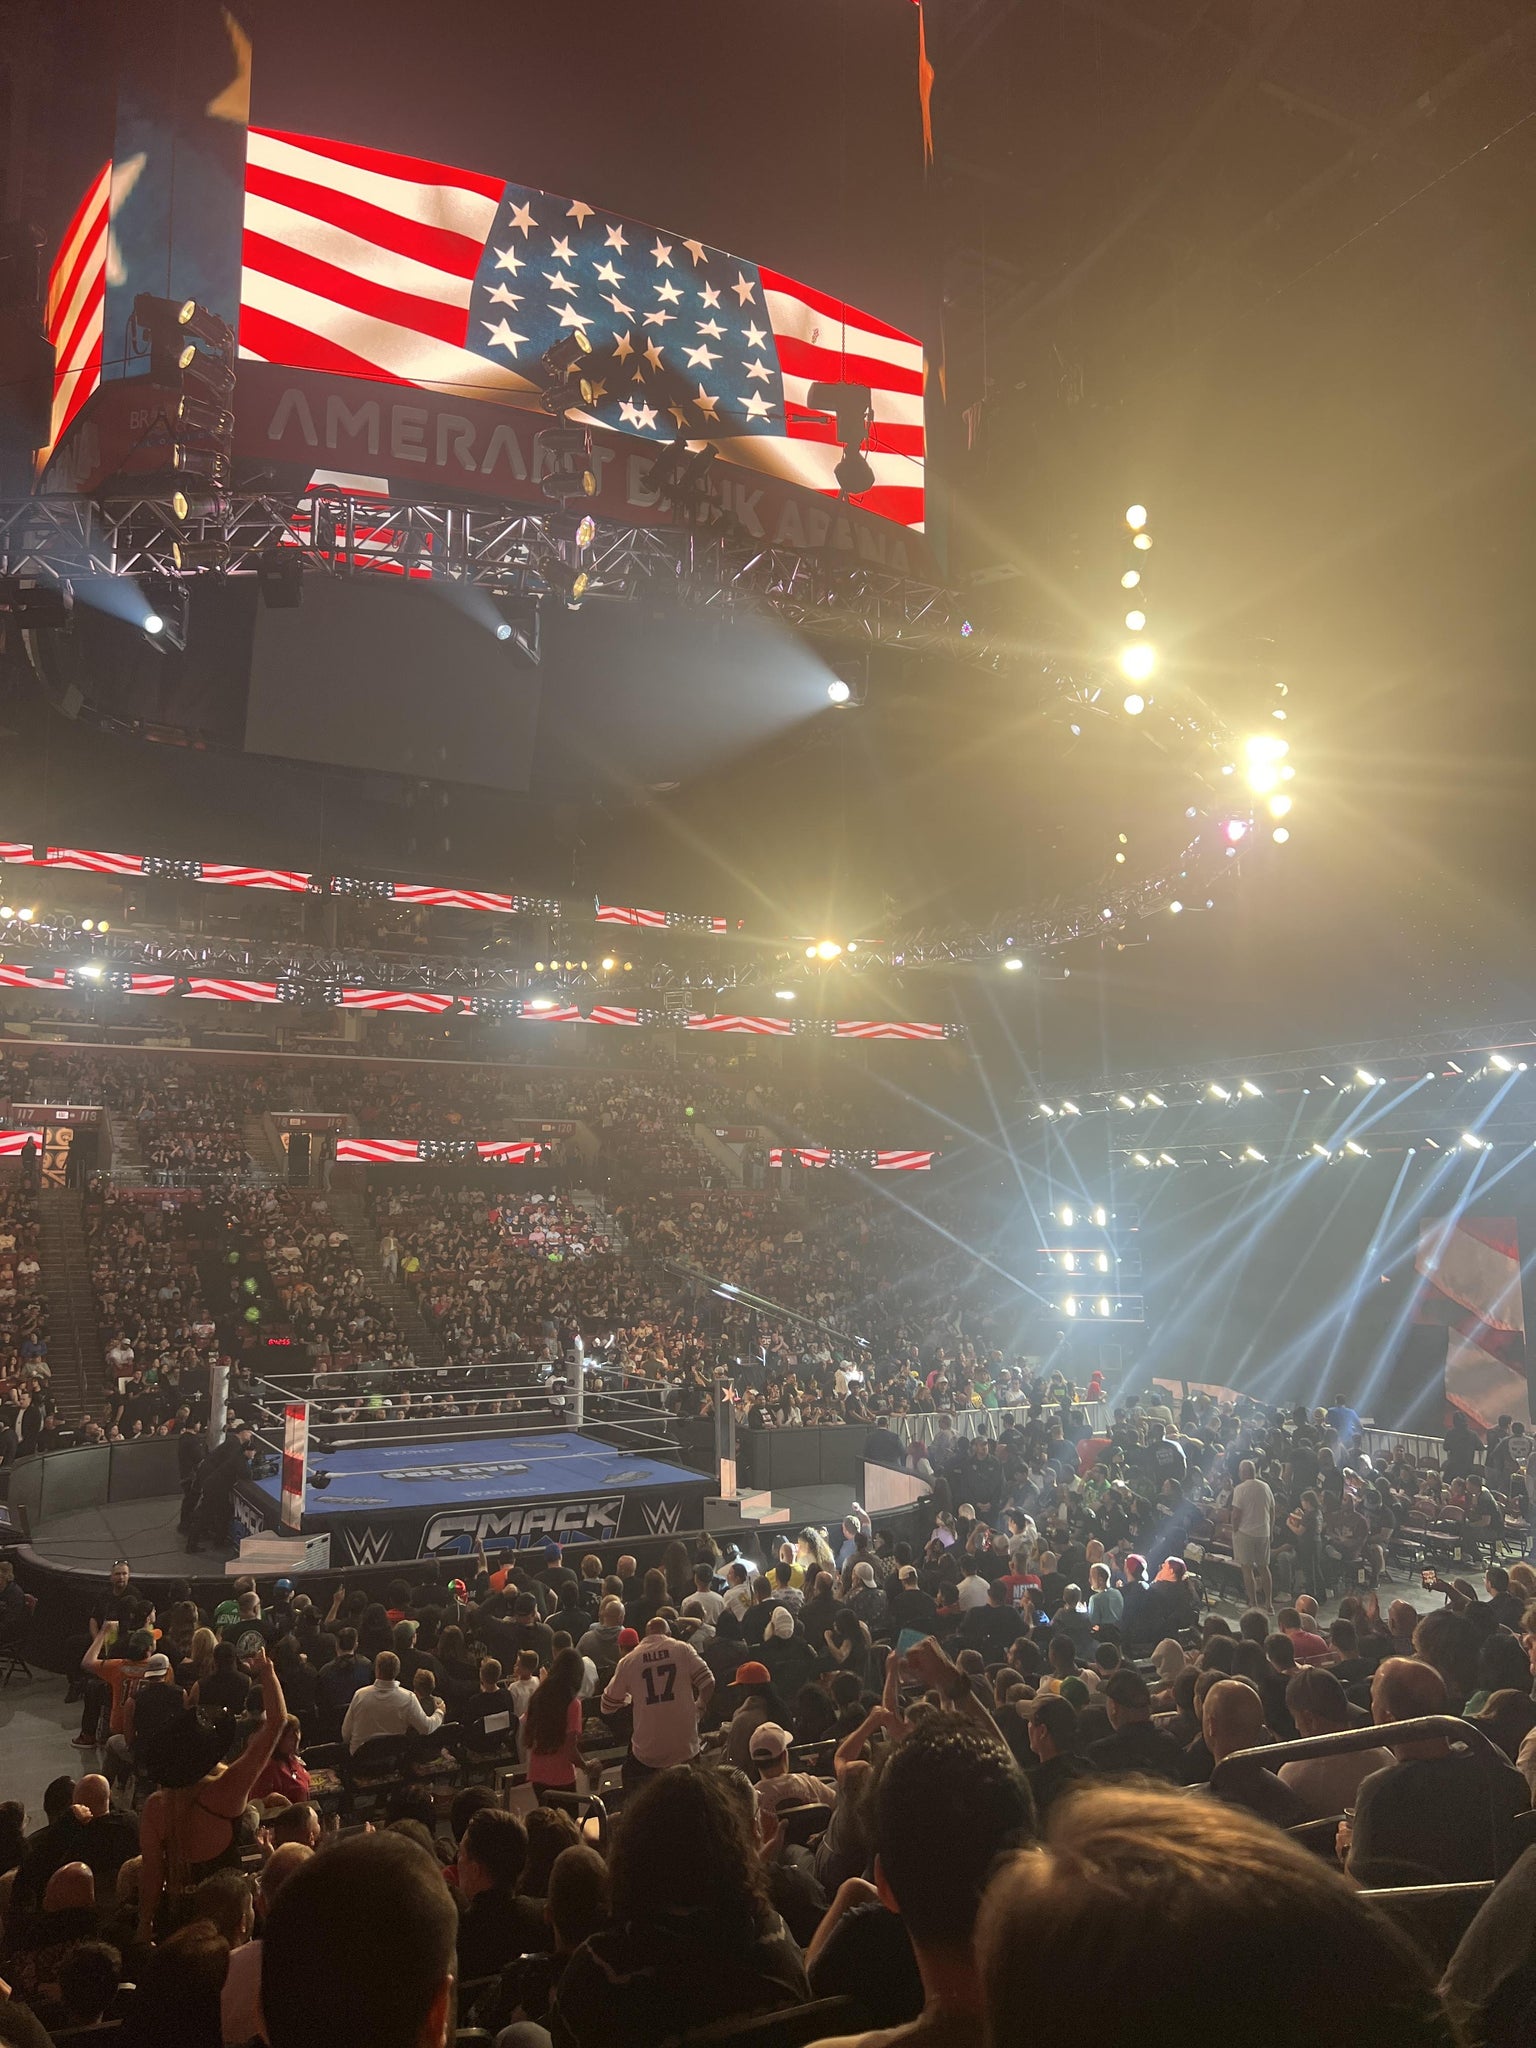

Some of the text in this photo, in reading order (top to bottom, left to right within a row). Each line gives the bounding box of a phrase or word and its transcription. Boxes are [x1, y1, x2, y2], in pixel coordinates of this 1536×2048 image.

[267, 387, 615, 496] AMERANT
[626, 453, 766, 538] BNK
[17, 1109, 35, 1119] 117
[80, 1110, 97, 1121] 118
[426, 1501, 622, 1551] SMACK
[642, 1663, 677, 1706] 17
